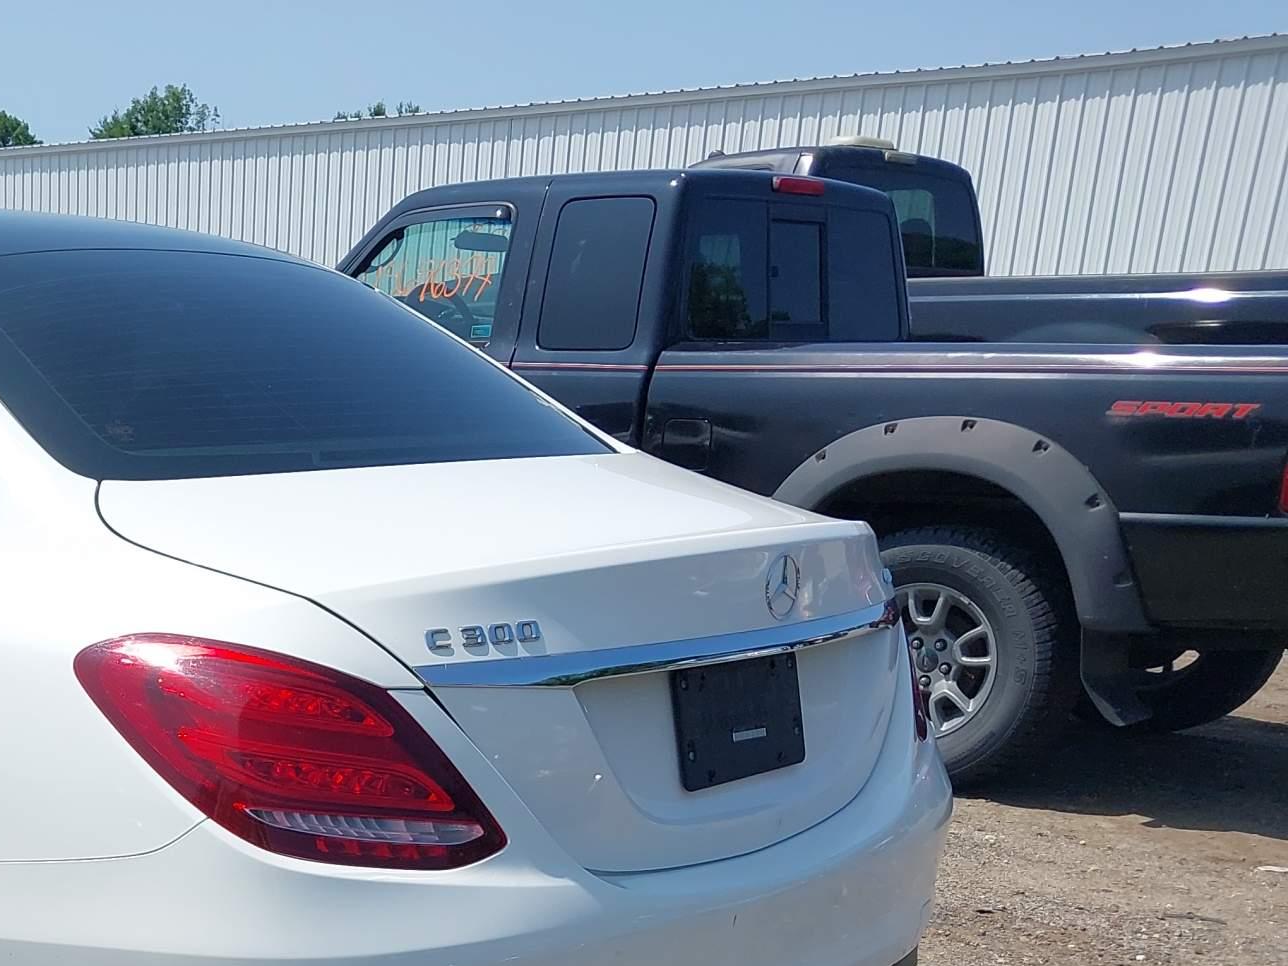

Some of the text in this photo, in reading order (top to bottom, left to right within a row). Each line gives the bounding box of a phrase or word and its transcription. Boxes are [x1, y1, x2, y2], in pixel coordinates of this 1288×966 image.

[1105, 400, 1261, 419] SPORT
[890, 550, 1017, 618] SCOVERER
[424, 619, 543, 653] C 300
